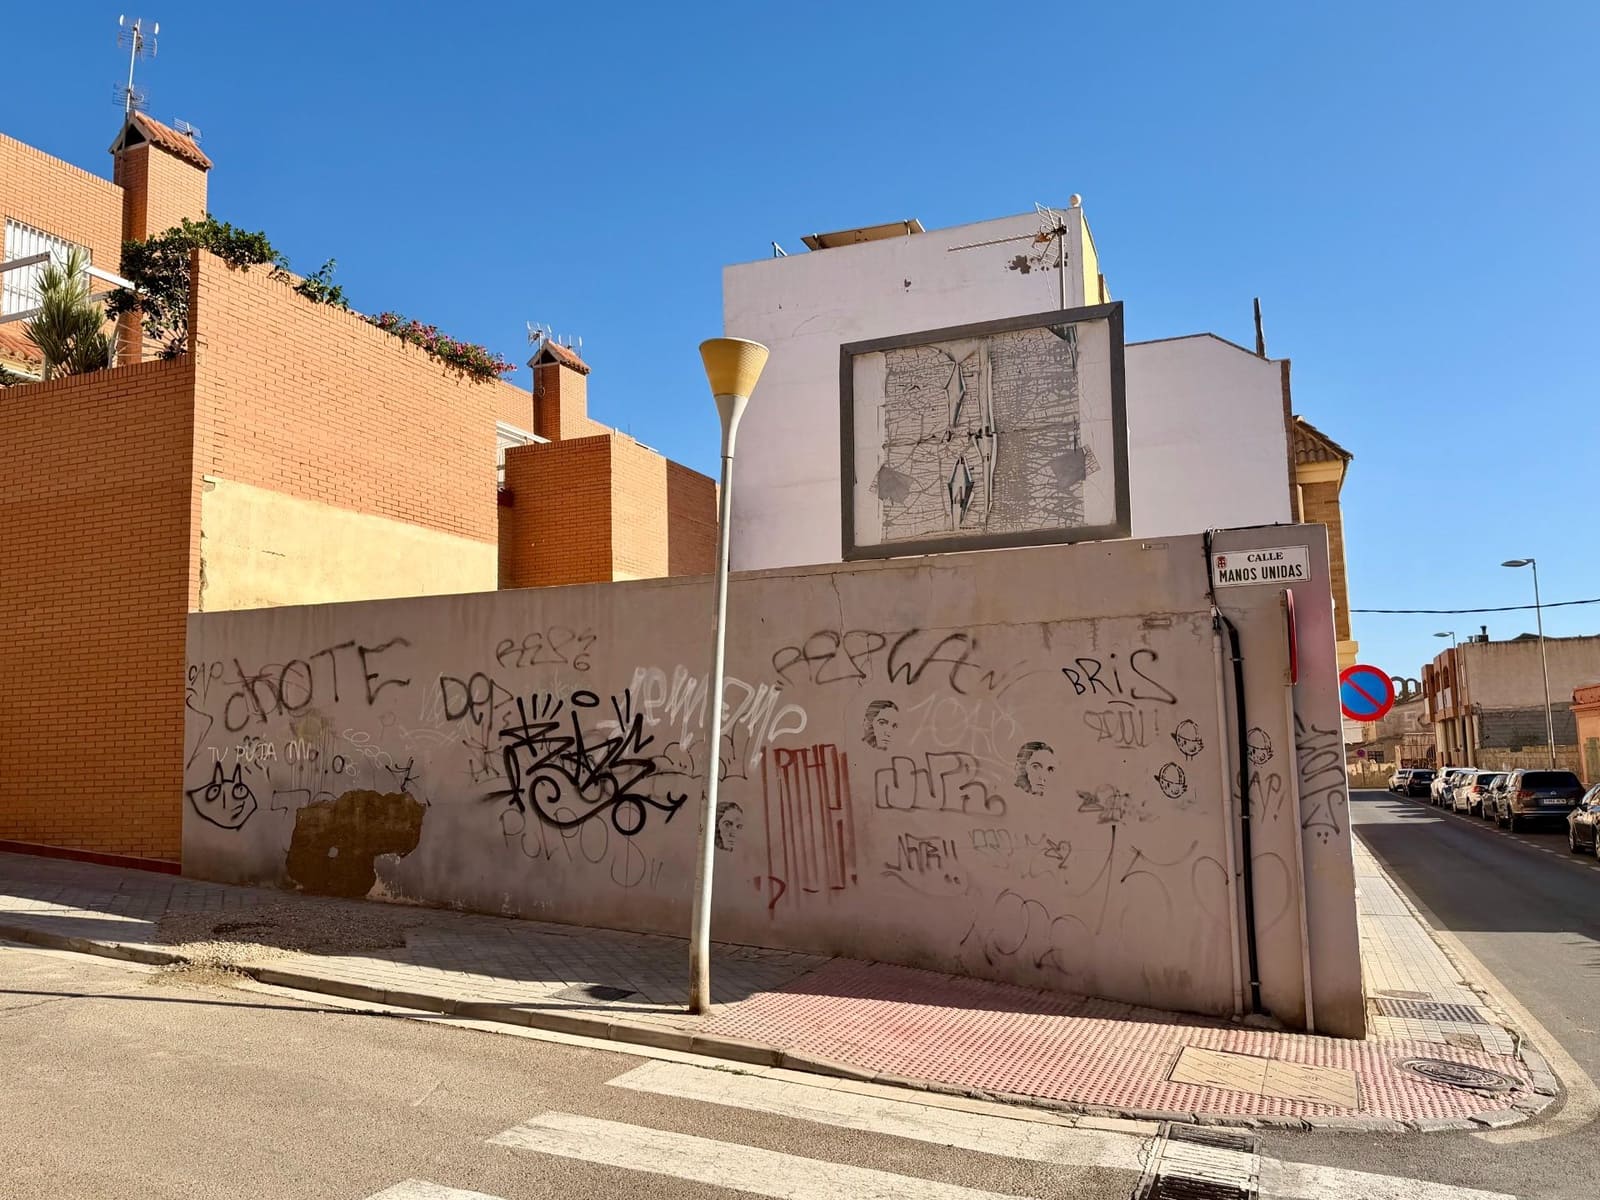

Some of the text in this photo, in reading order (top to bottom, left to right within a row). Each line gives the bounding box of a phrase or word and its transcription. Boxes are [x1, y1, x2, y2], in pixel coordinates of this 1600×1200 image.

[1247, 552, 1284, 562] CALLE
[1219, 564, 1303, 582] MANOS UNIDAS
